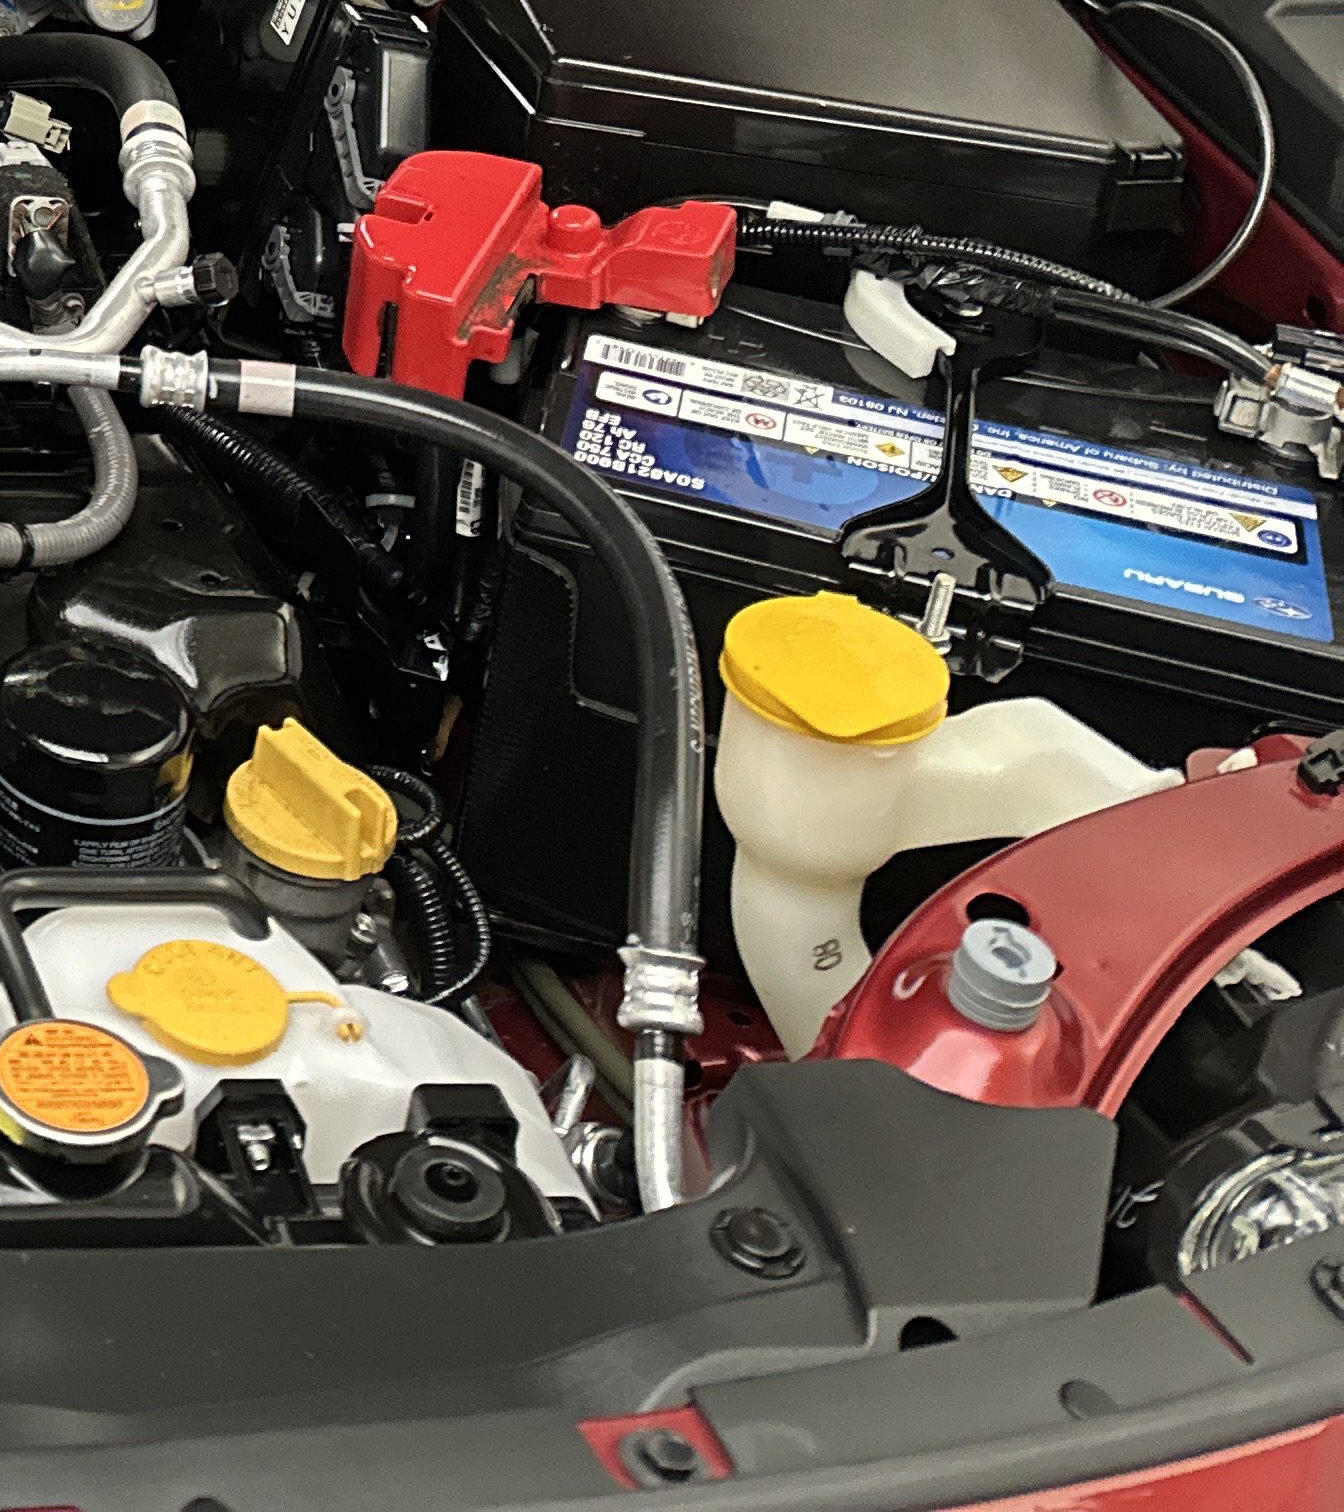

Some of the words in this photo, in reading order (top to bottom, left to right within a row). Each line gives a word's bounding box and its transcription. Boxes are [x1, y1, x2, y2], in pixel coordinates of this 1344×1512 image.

[838, 394, 884, 411] 08103
[888, 404, 908, 415] NJ
[585, 408, 621, 426] EFB
[579, 430, 613, 447] 120
[609, 426, 637, 439] Ah
[618, 439, 646, 453] RC
[616, 449, 655, 466] CCA
[1191, 469, 1278, 495] Distributed
[1123, 568, 1246, 604] SUBARU
